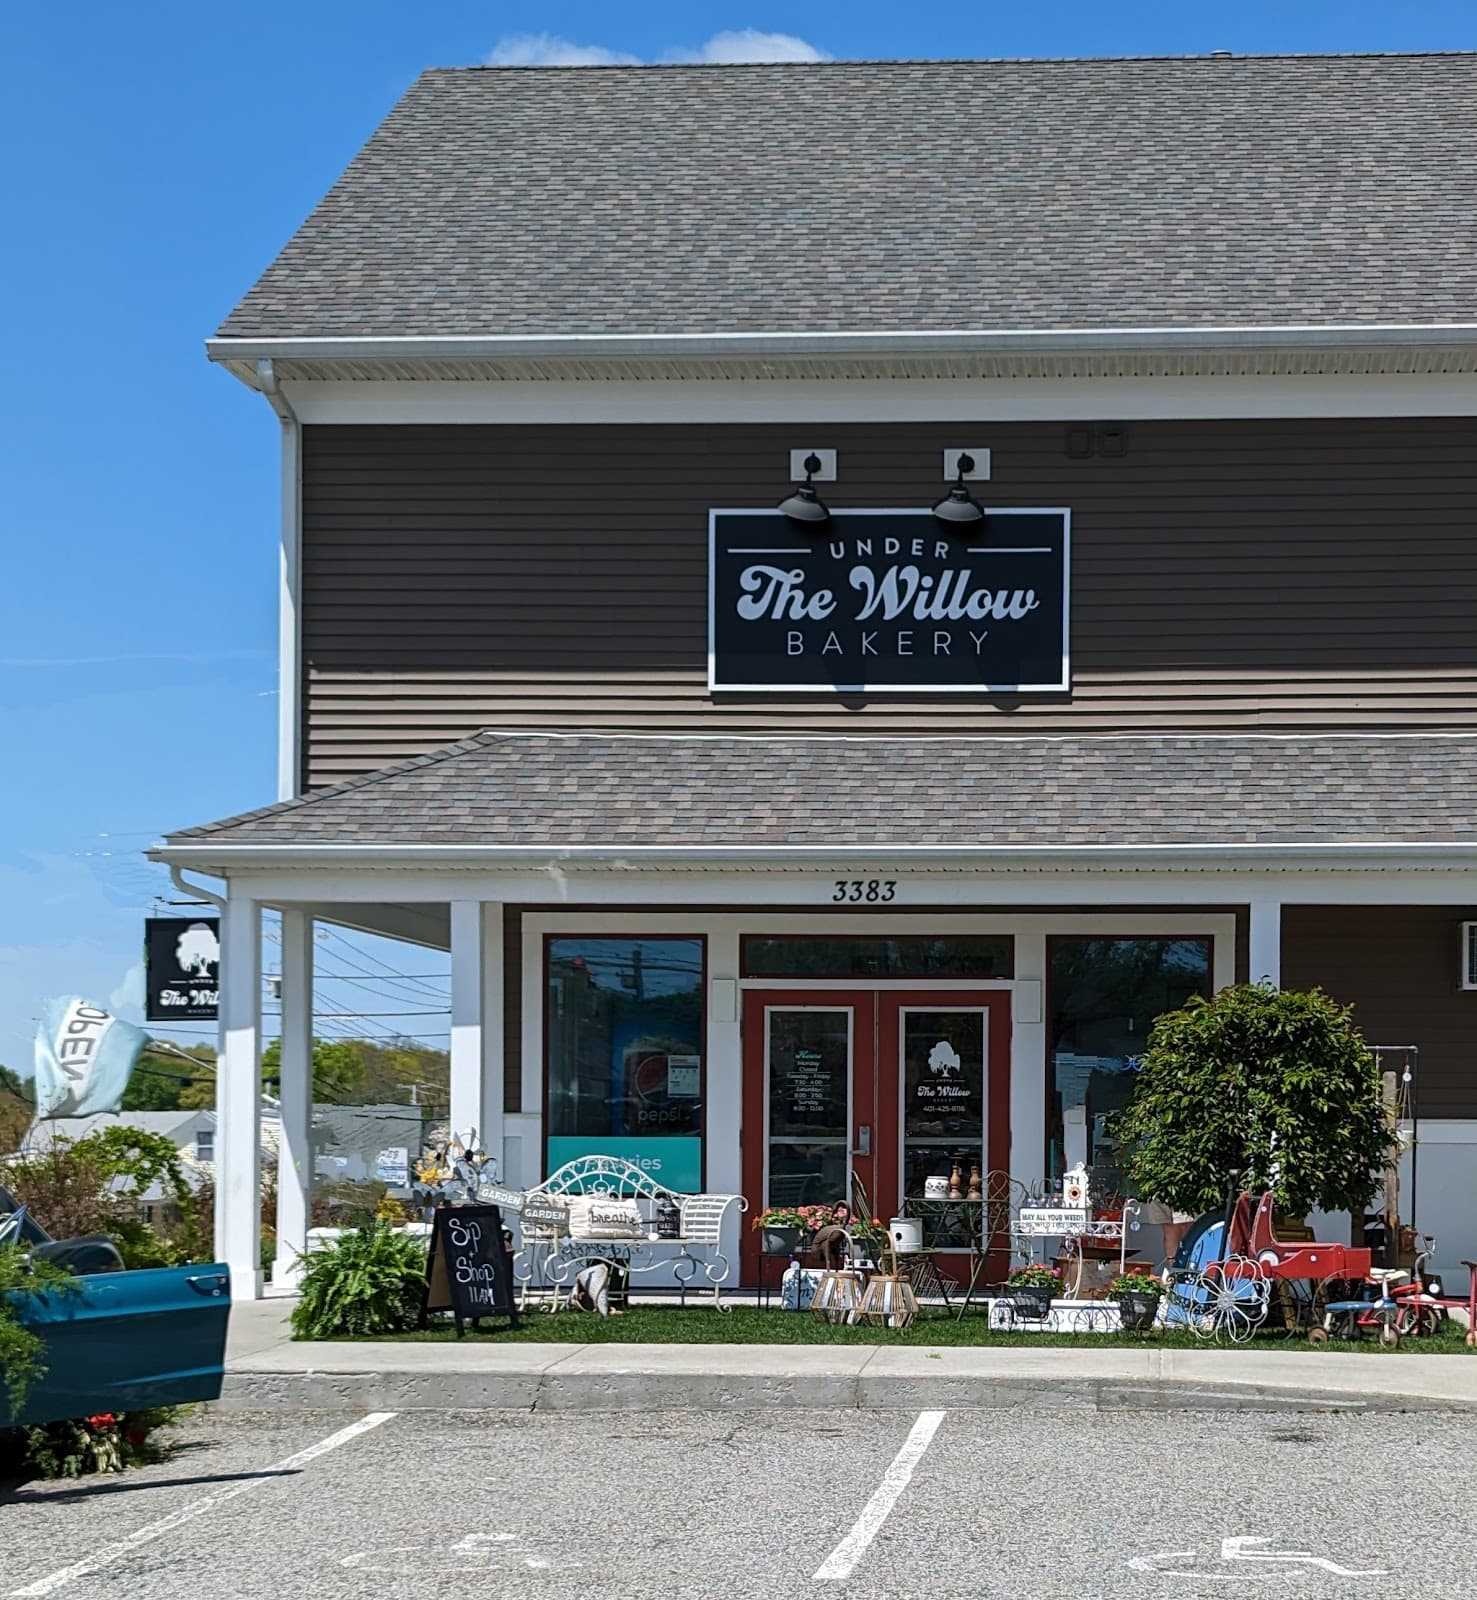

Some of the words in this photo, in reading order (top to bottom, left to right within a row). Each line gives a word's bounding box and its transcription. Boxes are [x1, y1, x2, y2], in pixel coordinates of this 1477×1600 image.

[829, 537, 950, 560] UNDER
[736, 564, 838, 621] The
[848, 564, 1041, 621] Willow
[786, 630, 989, 656] BAKERY
[832, 879, 897, 902] 3383
[159, 989, 189, 1006] The
[917, 1085, 936, 1097] The
[937, 1085, 971, 1097] Willow
[480, 1188, 522, 1207] GARDEN
[524, 1208, 566, 1221] GARDEN
[448, 1217, 482, 1253] Sip
[455, 1256, 495, 1290] Shop
